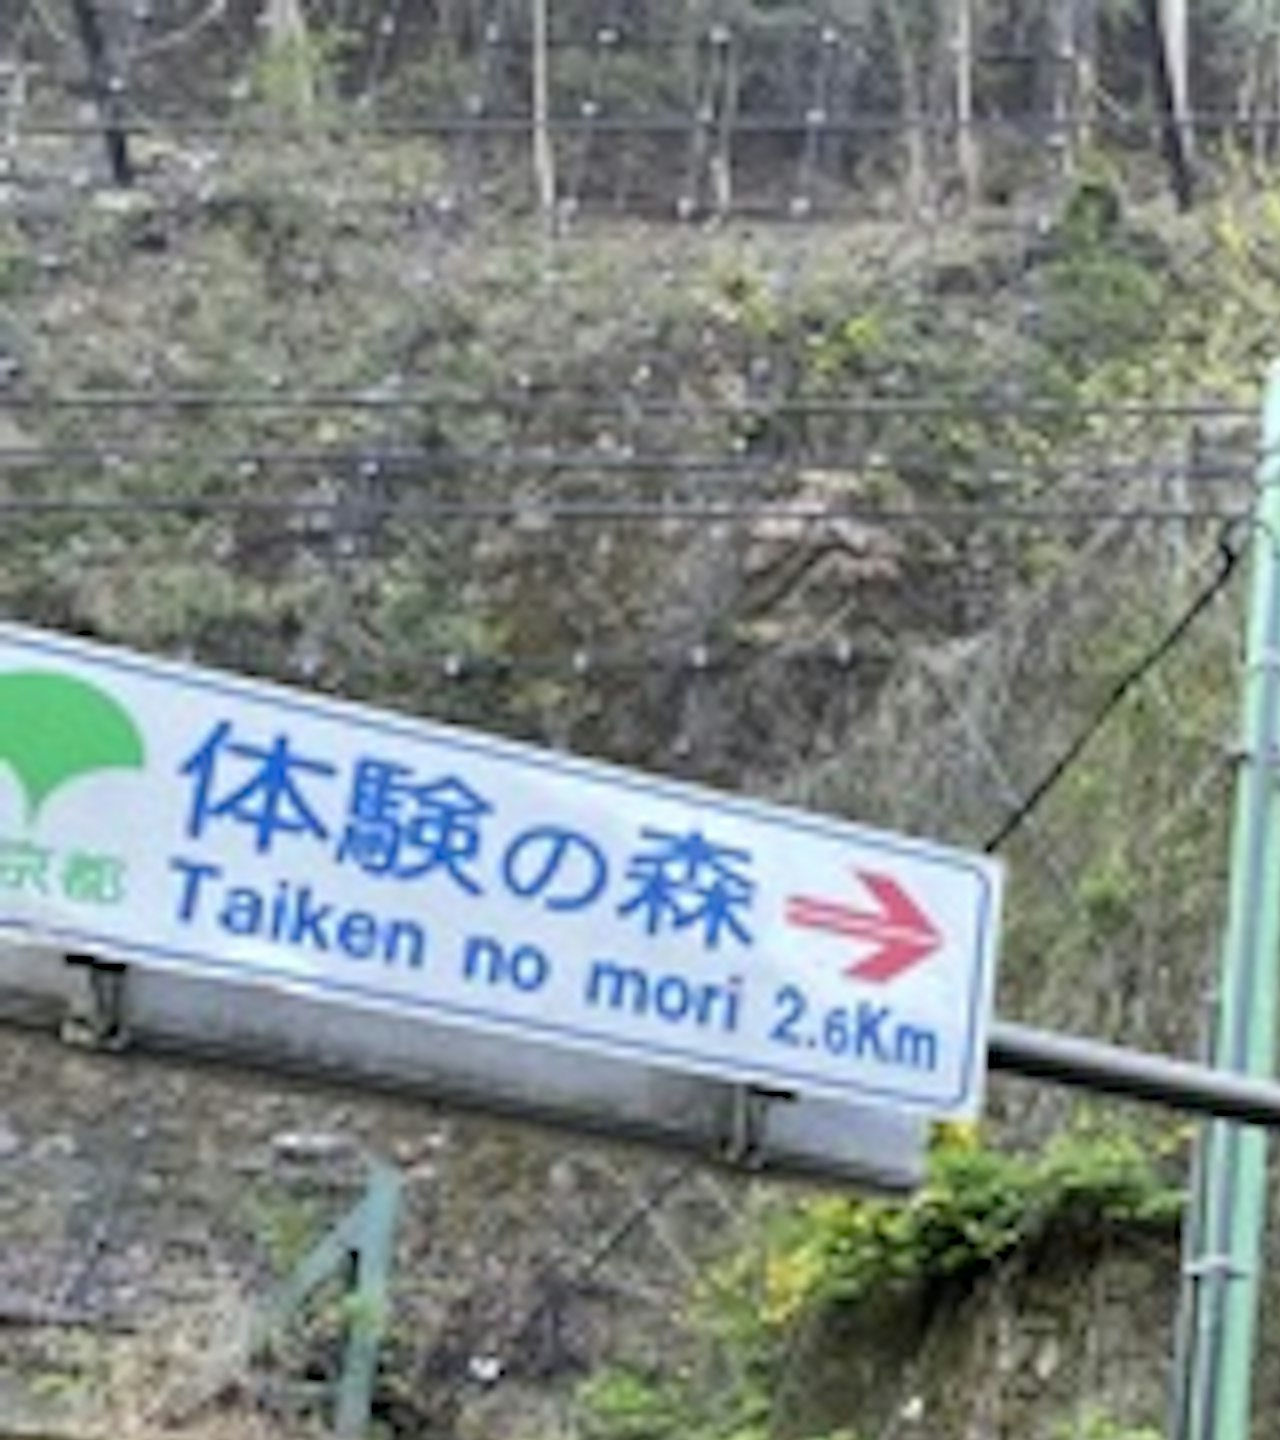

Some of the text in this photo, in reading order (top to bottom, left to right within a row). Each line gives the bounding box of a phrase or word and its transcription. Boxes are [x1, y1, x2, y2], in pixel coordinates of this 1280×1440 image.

[179, 719, 756, 952] 体験の森
[167, 857, 939, 1074] Taiken no mori 2.6Km
